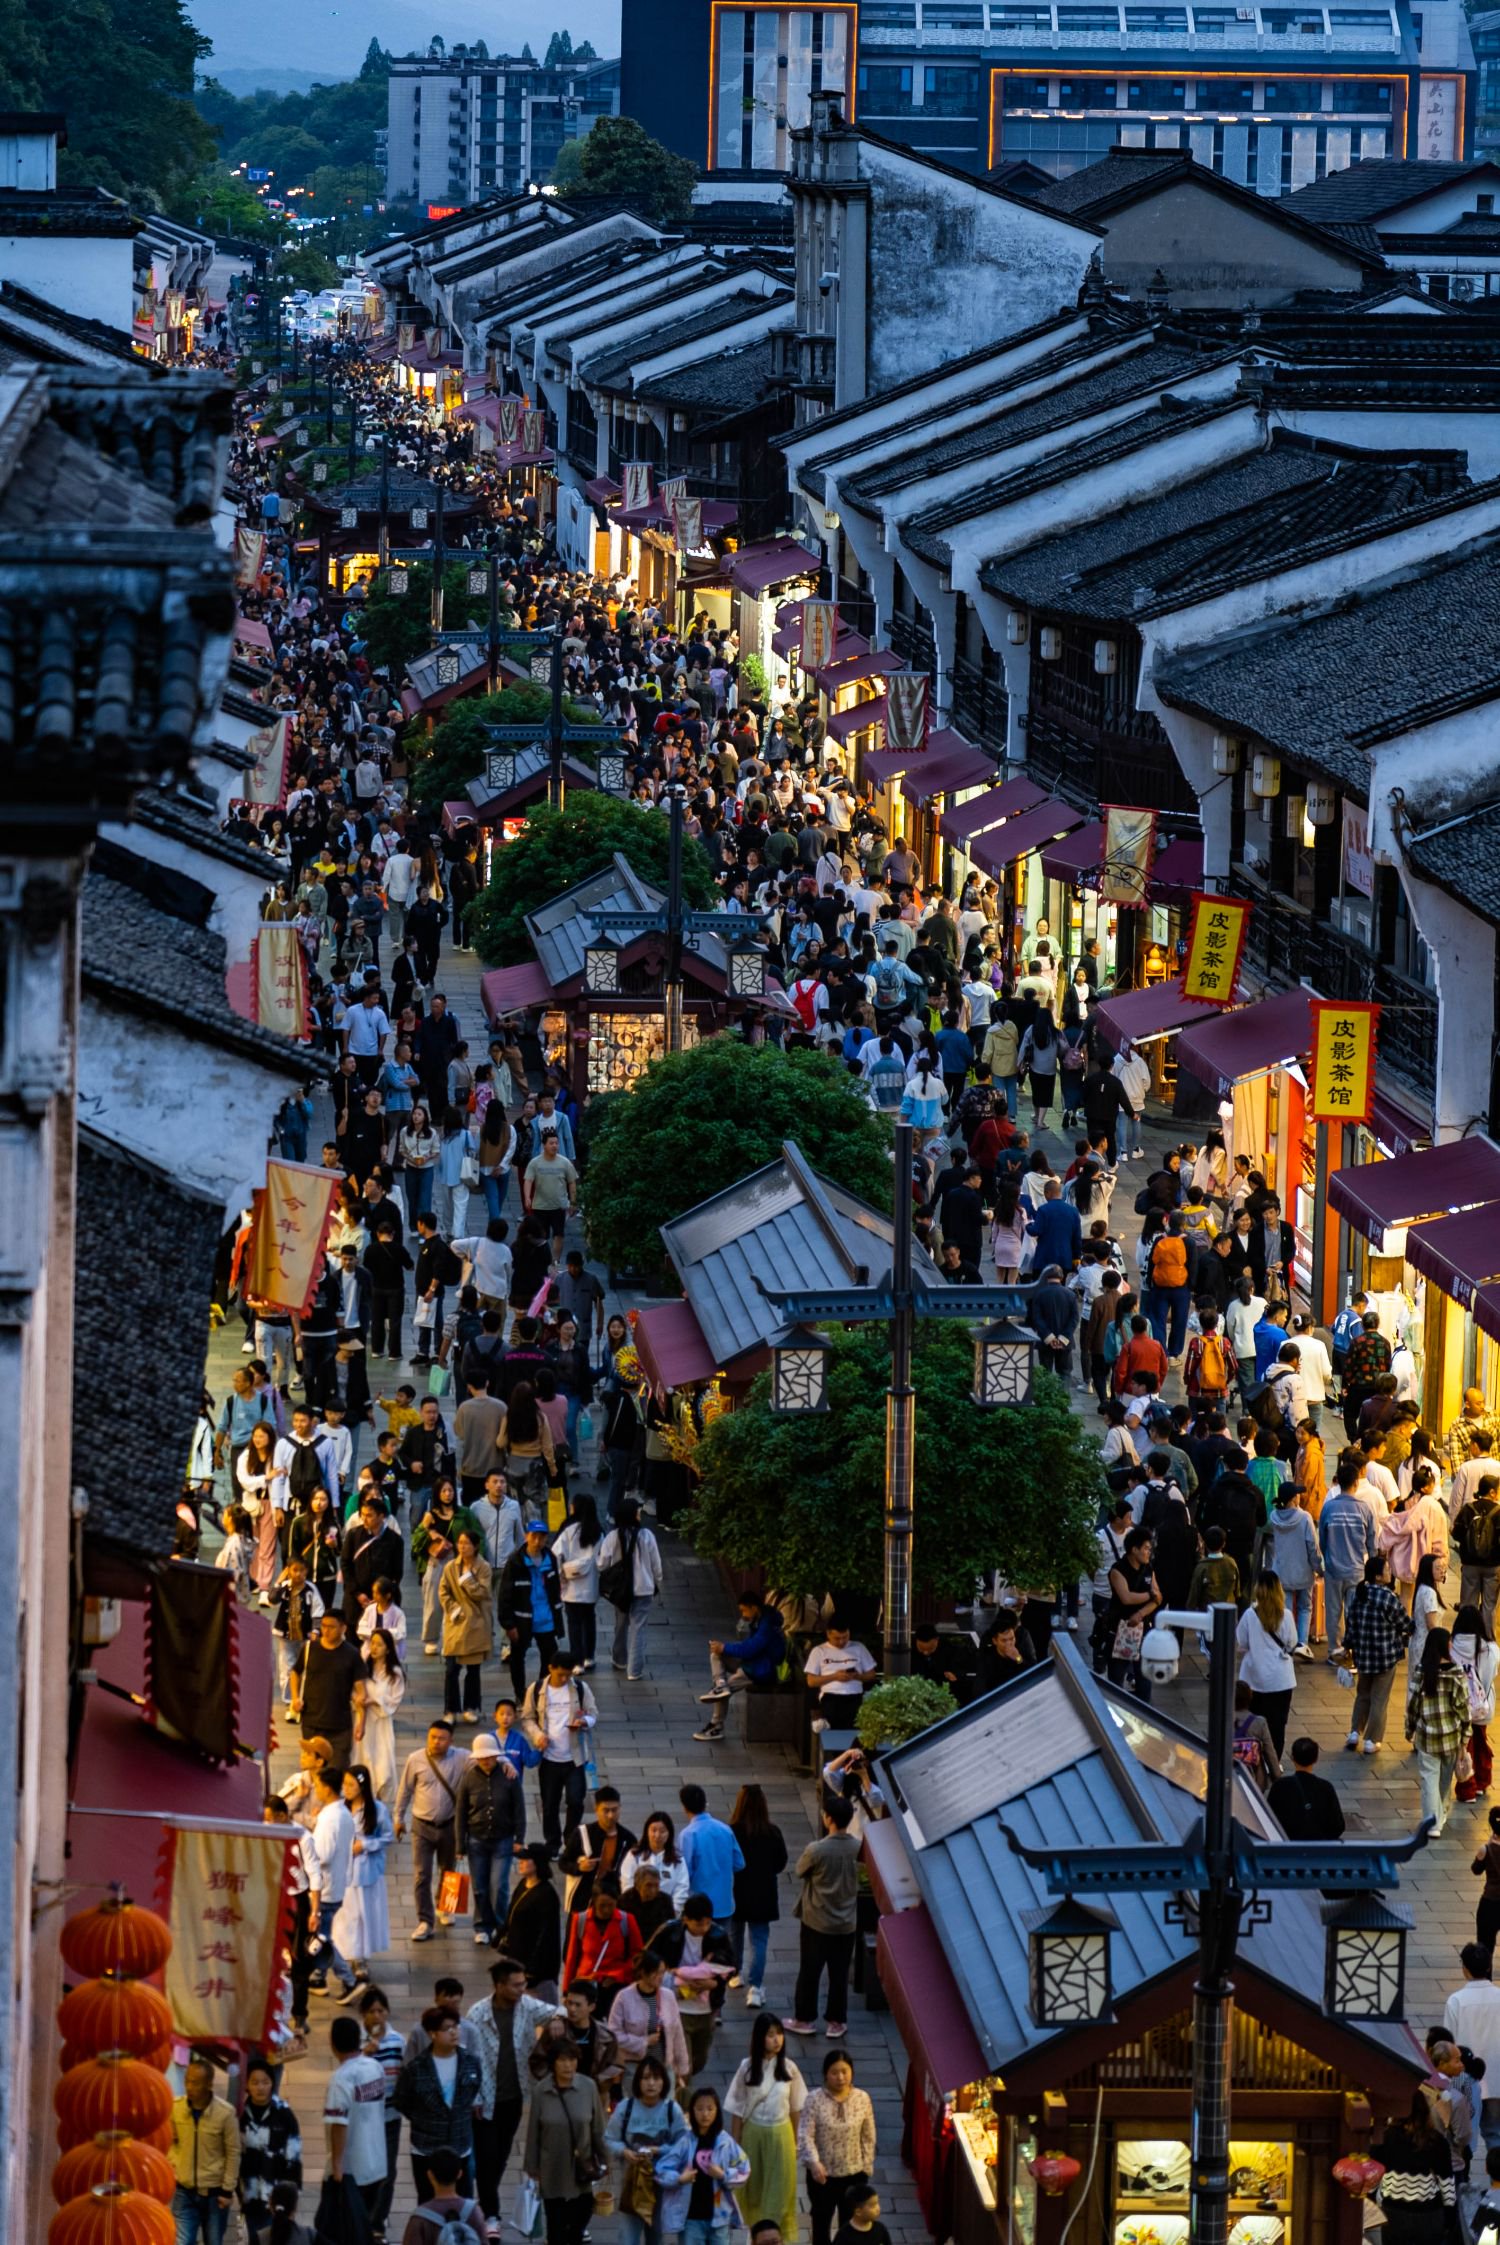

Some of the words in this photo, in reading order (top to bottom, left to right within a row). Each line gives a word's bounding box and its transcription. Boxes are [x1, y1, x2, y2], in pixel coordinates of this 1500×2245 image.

[275, 956, 296, 1008] 汉服馆
[1198, 912, 1230, 989] 皮影茶馆
[1328, 1019, 1356, 1105] 皮影茶馆
[266, 1197, 306, 1279] 今年十八
[194, 1870, 249, 1999] 狮峰龙井
